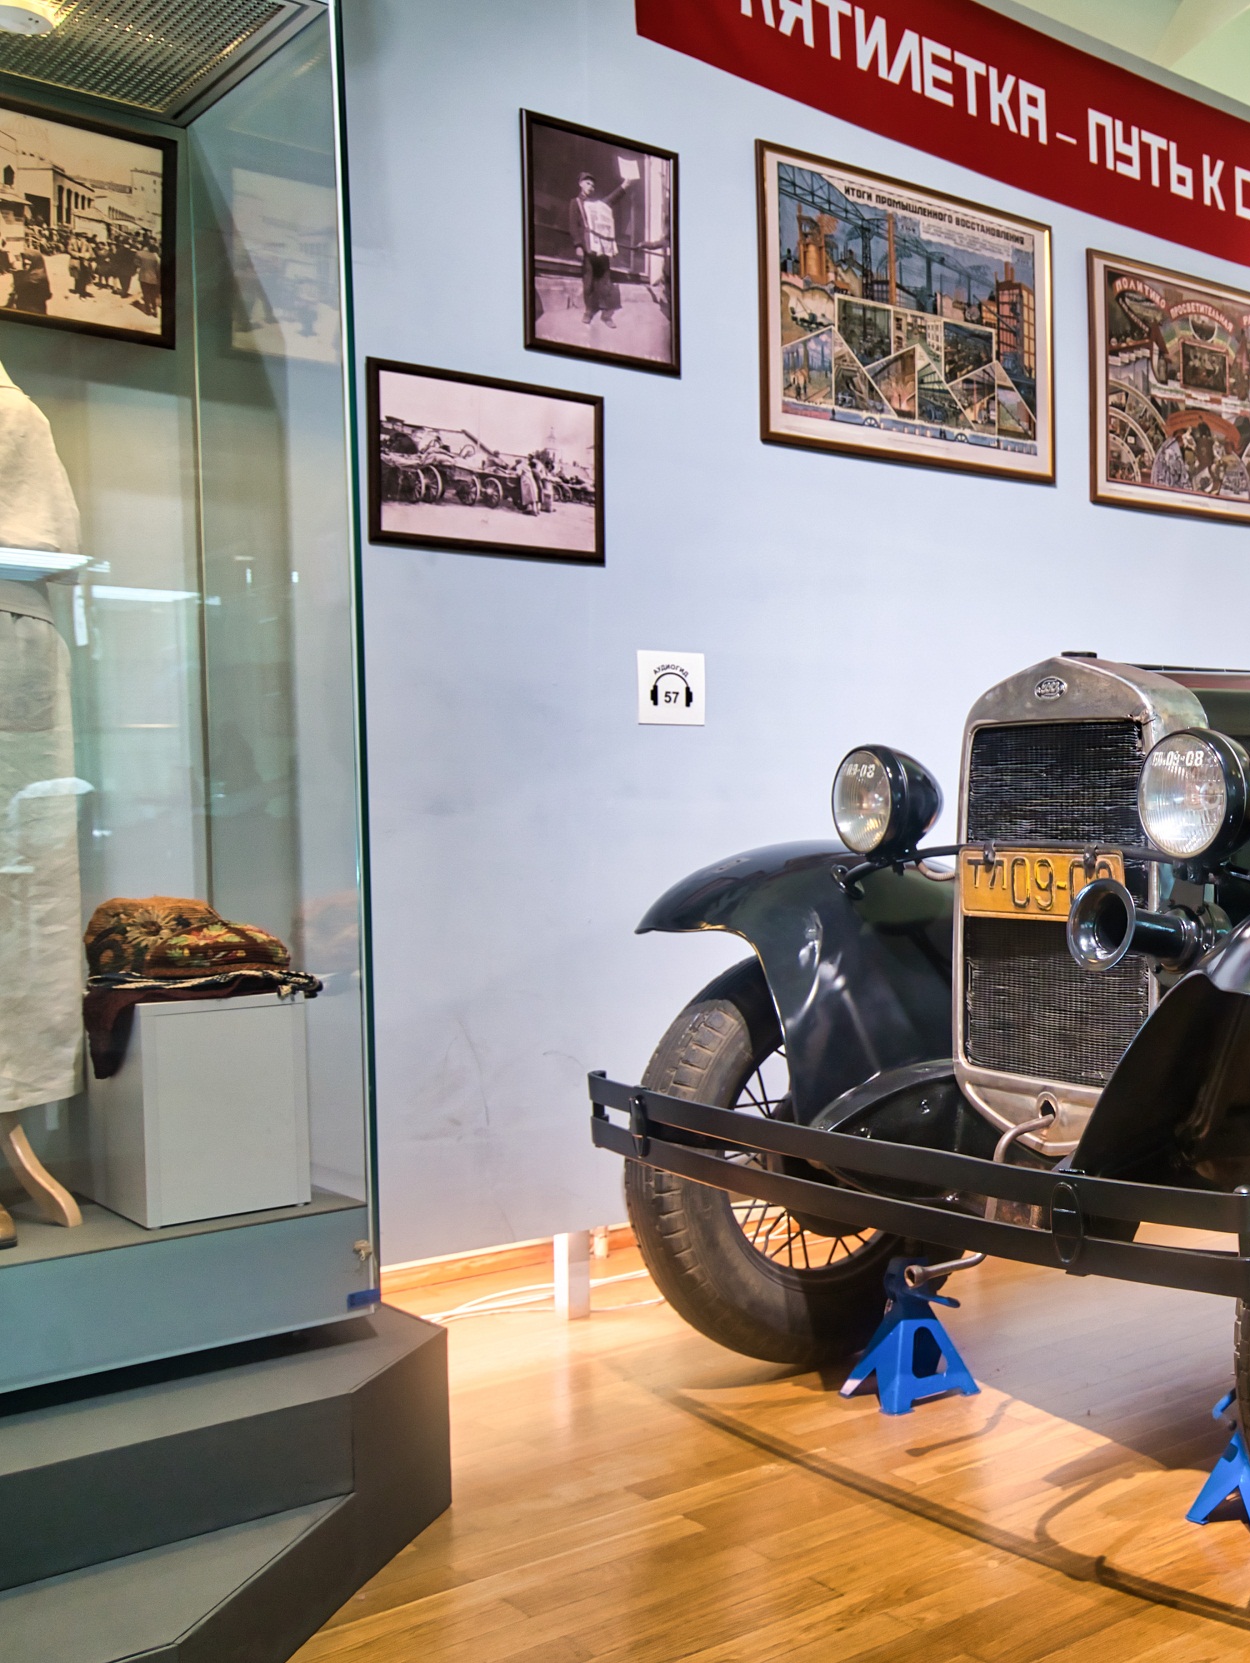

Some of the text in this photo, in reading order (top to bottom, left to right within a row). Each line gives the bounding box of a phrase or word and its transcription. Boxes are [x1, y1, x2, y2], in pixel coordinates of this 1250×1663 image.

[1088, 107, 1193, 200] ПУТЬ
[1202, 154, 1225, 212] К
[844, 185, 873, 202] ИТОГИ
[875, 194, 953, 224] ПРОМЫШЛЕННОГО
[955, 215, 1025, 246] ВОССТАНОВЛЕНИЯ
[1169, 301, 1234, 332] ПРОСВЕТИТЕЛЬНАЯ
[653, 664, 689, 678] АУДИОГИД
[664, 691, 680, 704] 57
